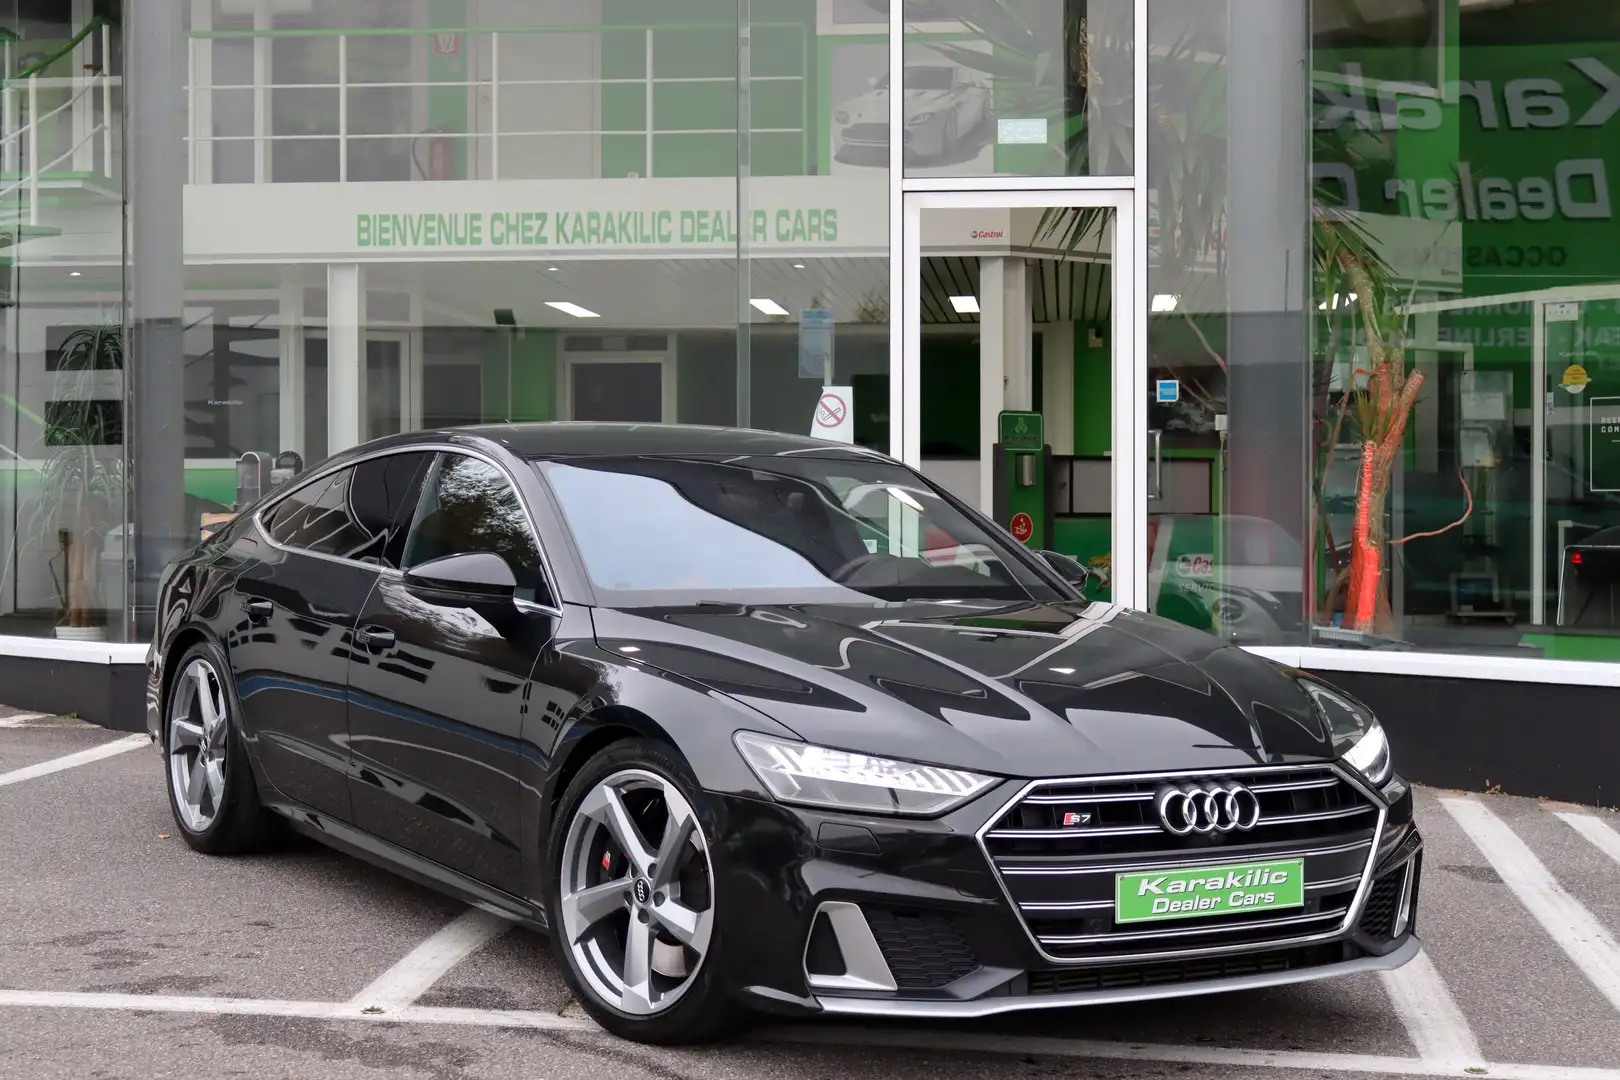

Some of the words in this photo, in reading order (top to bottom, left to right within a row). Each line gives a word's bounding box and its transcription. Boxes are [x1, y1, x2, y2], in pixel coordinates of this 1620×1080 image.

[357, 213, 482, 247] BIENVENUE
[490, 212, 548, 246] CHEZ
[556, 210, 672, 245] KARAKILIC
[680, 209, 767, 243] DEALR
[776, 208, 838, 242] CARS
[979, 230, 1004, 238] Castrol
[1069, 814, 1091, 823] S7
[1138, 868, 1288, 896] Karakilic
[1152, 895, 1221, 914] Dealer
[1228, 891, 1275, 907] Cars
